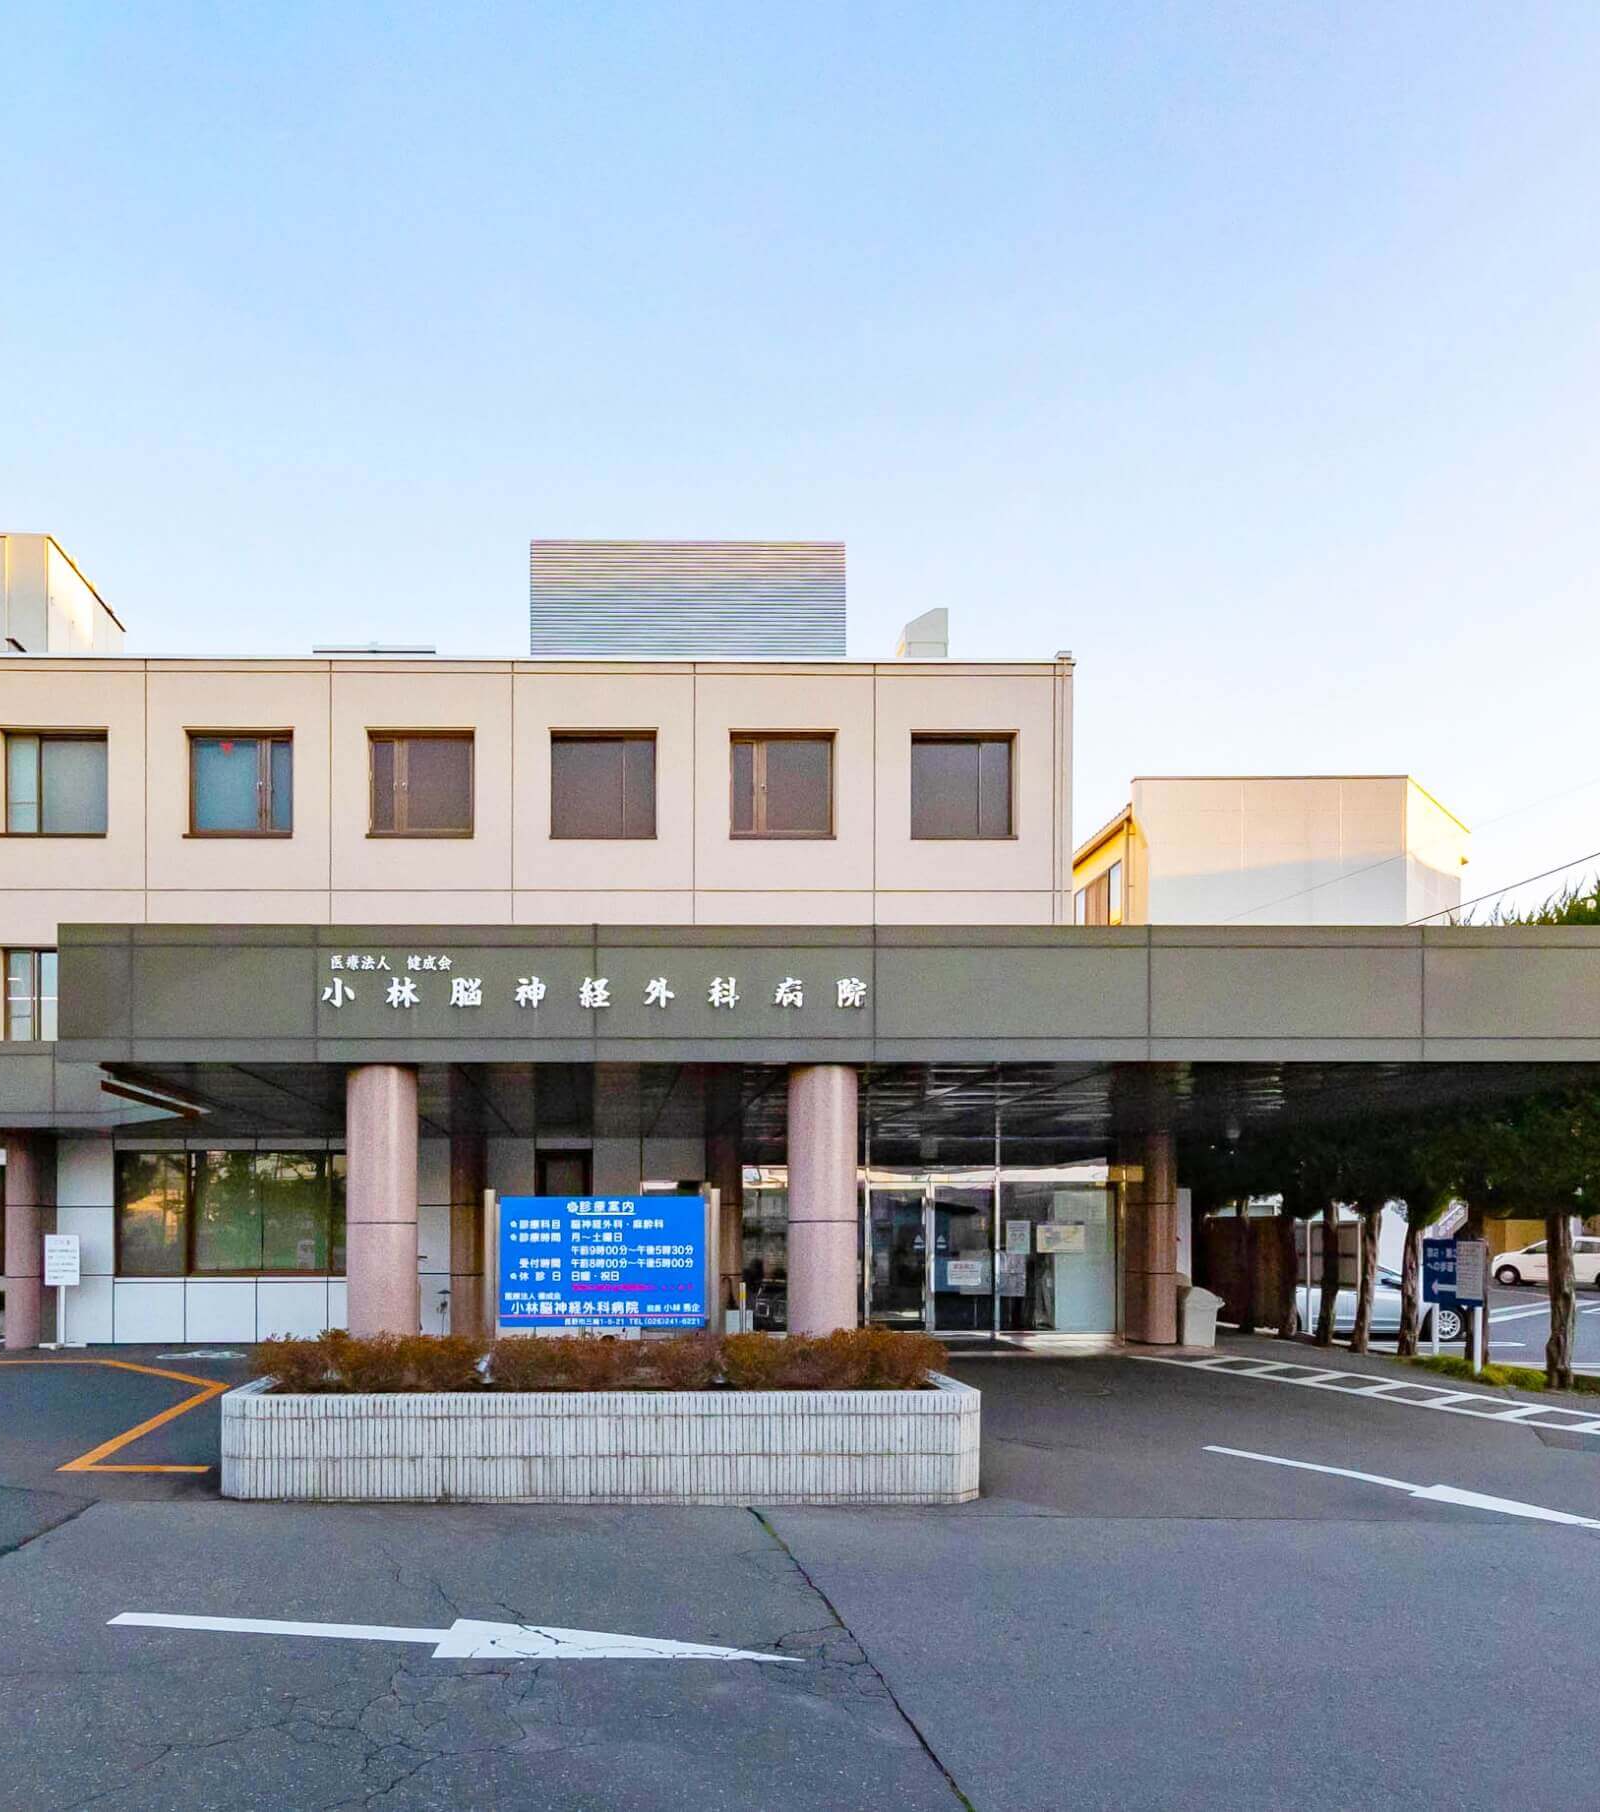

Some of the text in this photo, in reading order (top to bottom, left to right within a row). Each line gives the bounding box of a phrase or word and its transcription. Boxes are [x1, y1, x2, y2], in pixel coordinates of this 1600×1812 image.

[330, 955, 453, 971] 医療法人 健成会
[321, 976, 869, 1008] 小林脳神経外科病院
[579, 1201, 635, 1213] 診療案内
[511, 1301, 639, 1314] 小林脳神経外科病院
